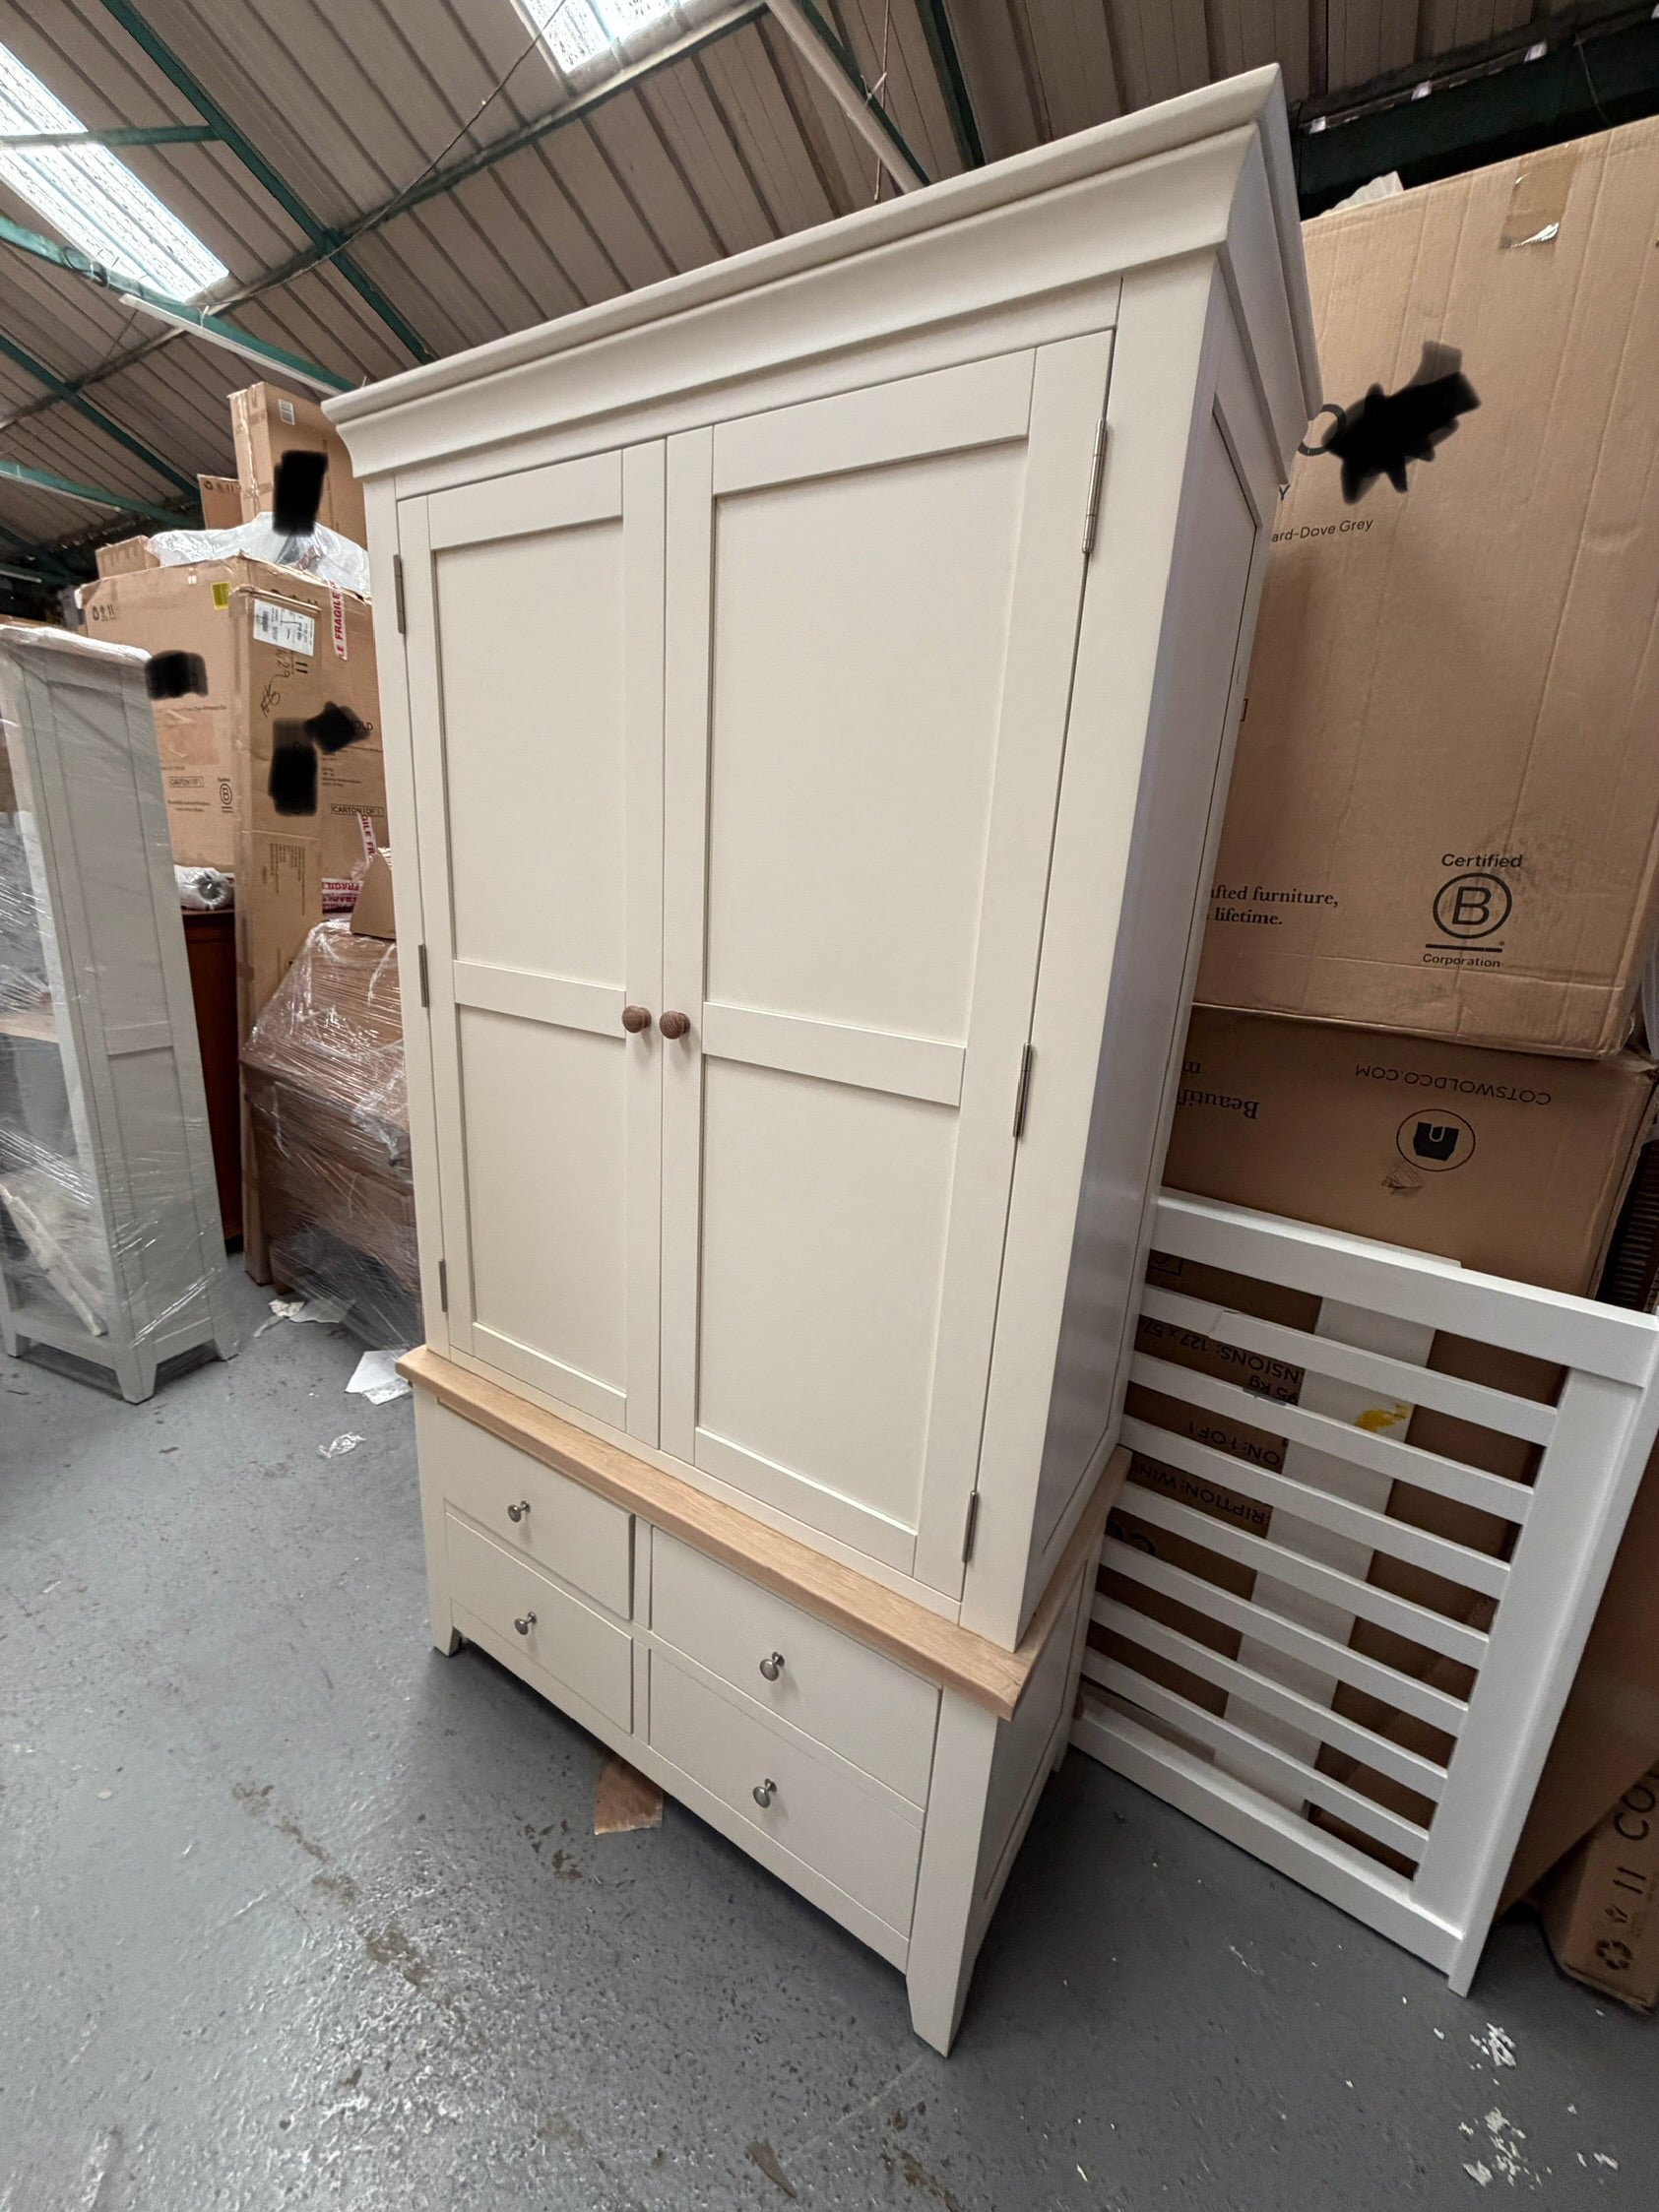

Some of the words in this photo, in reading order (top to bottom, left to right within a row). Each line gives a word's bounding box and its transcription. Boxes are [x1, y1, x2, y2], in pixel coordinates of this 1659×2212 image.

[1339, 519, 1373, 533] Grey
[333, 592, 344, 641] FRAGILE
[1440, 853, 1524, 868] Certified
[1252, 885, 1338, 909] furniture,
[1451, 885, 1492, 926] B
[1214, 906, 1283, 926] lifetime.
[1422, 952, 1500, 969] Corporation
[1354, 1062, 1553, 1106] COTSWOLDCO.COM
[1177, 1088, 1260, 1120] Beautif
[1180, 1334, 1207, 1353] 127
[1216, 1343, 1306, 1384] NSIONS:
[1197, 1426, 1227, 1445] OF
[1244, 1441, 1282, 1467] ON:
[1181, 1480, 1271, 1527] RIPTION:
